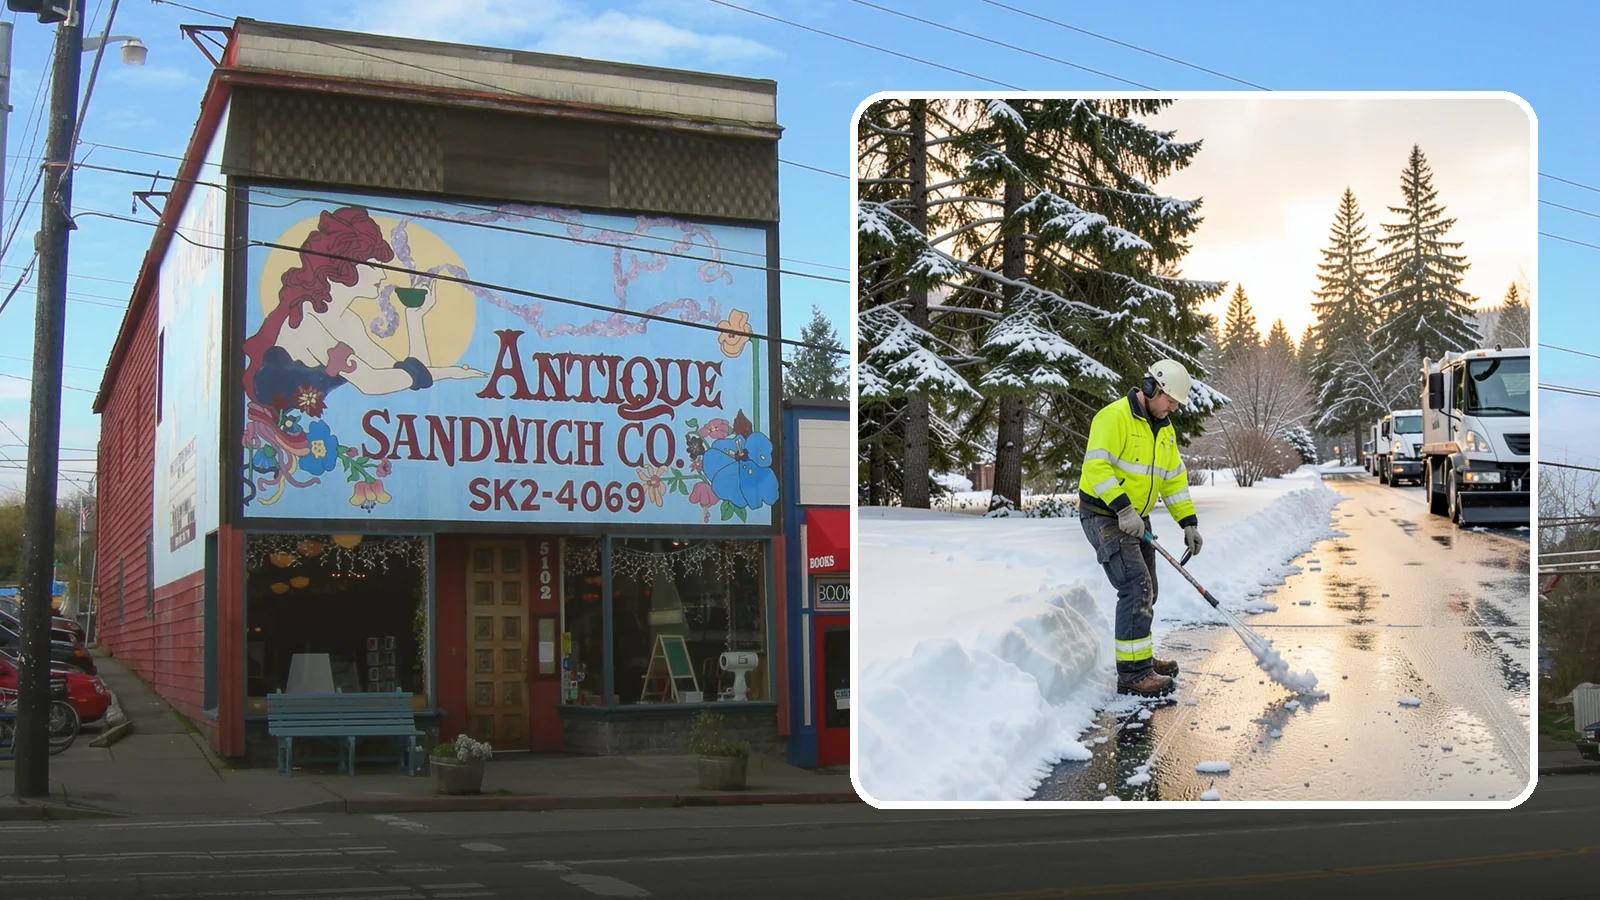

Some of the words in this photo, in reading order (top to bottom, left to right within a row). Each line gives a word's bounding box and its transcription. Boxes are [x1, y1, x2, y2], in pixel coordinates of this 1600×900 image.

[476, 329, 723, 420] ANTIQUE
[361, 408, 604, 467] SANDWICH
[617, 421, 684, 468] CO.
[468, 477, 645, 513] SK2-4069
[539, 542, 552, 600] 5102
[809, 554, 835, 569] BOOKS
